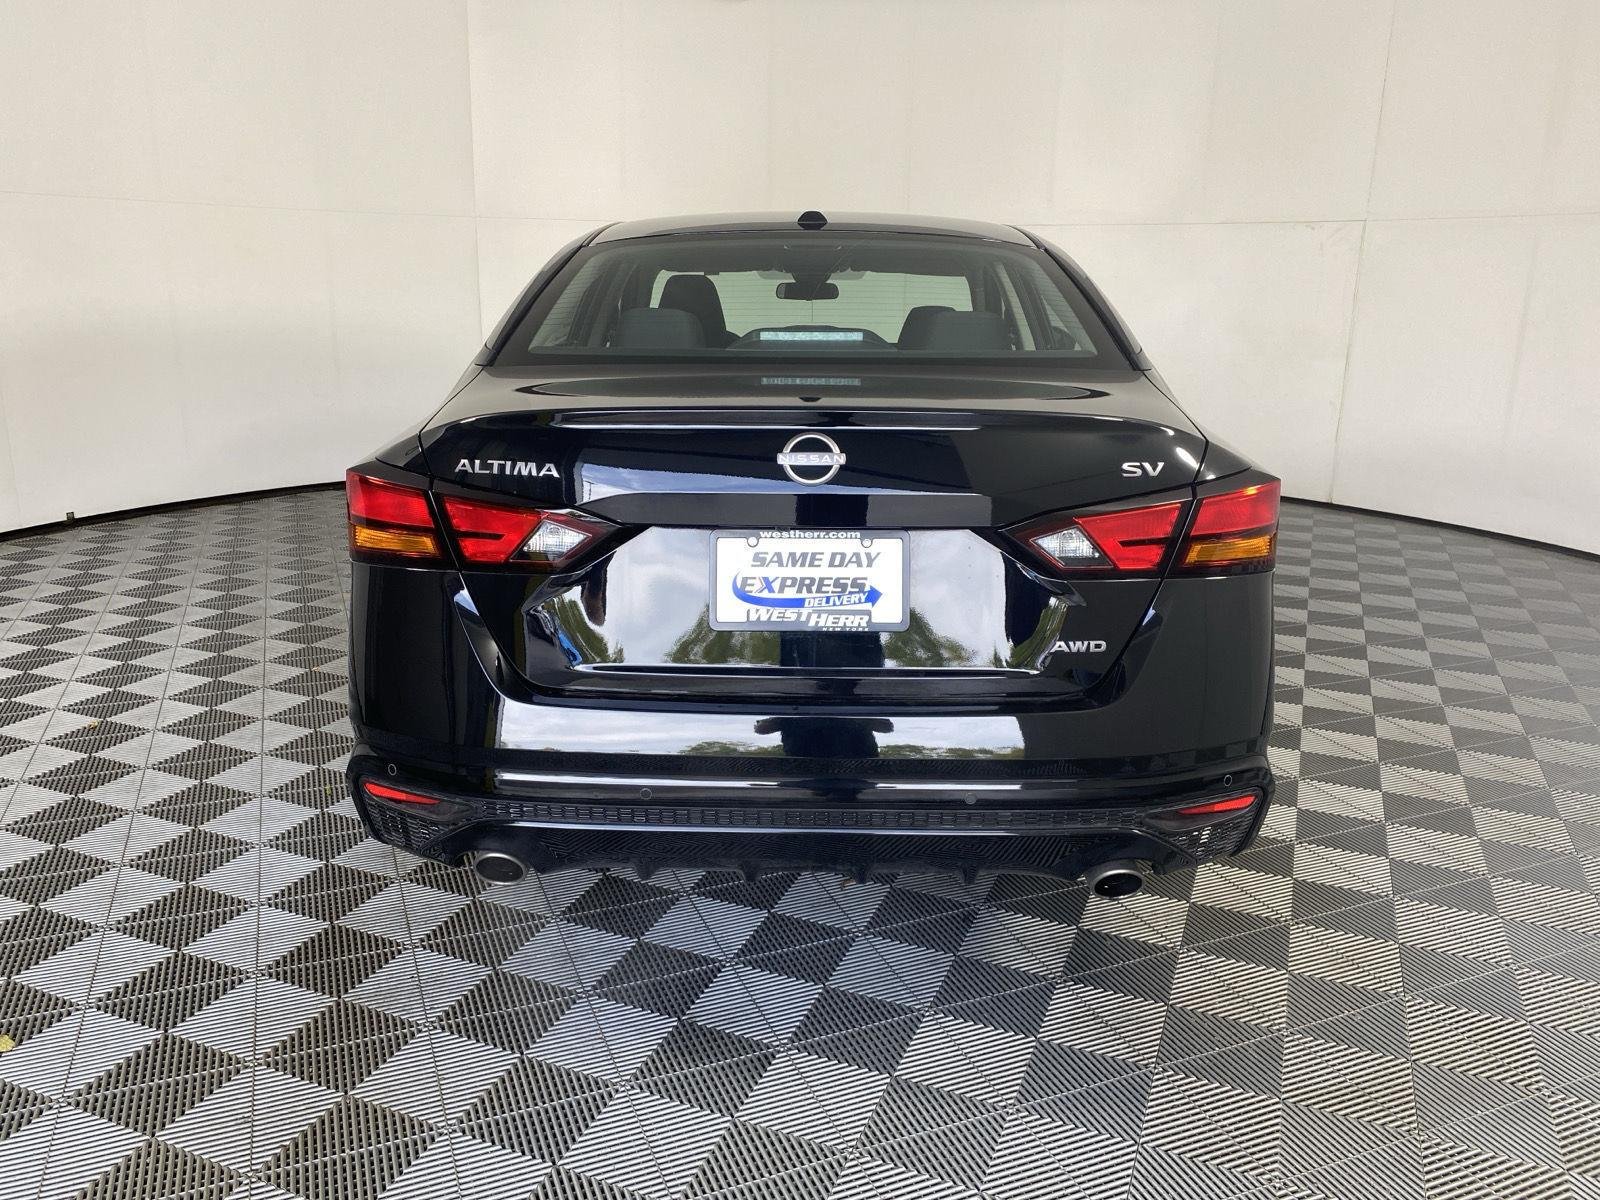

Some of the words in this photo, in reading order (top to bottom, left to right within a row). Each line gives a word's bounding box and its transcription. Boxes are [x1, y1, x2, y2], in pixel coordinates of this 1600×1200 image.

[778, 453, 846, 465] NISSAN
[455, 458, 560, 478] ALTIMA
[1121, 461, 1165, 477] SV
[759, 530, 861, 539] westherr.com
[751, 551, 824, 568] SAME
[828, 551, 882, 568] DAY
[740, 576, 868, 594] EXPRESS
[804, 592, 868, 608] DELIVERY
[748, 608, 813, 622] WEST
[808, 612, 870, 627] HERR
[1050, 640, 1107, 652] AWD
